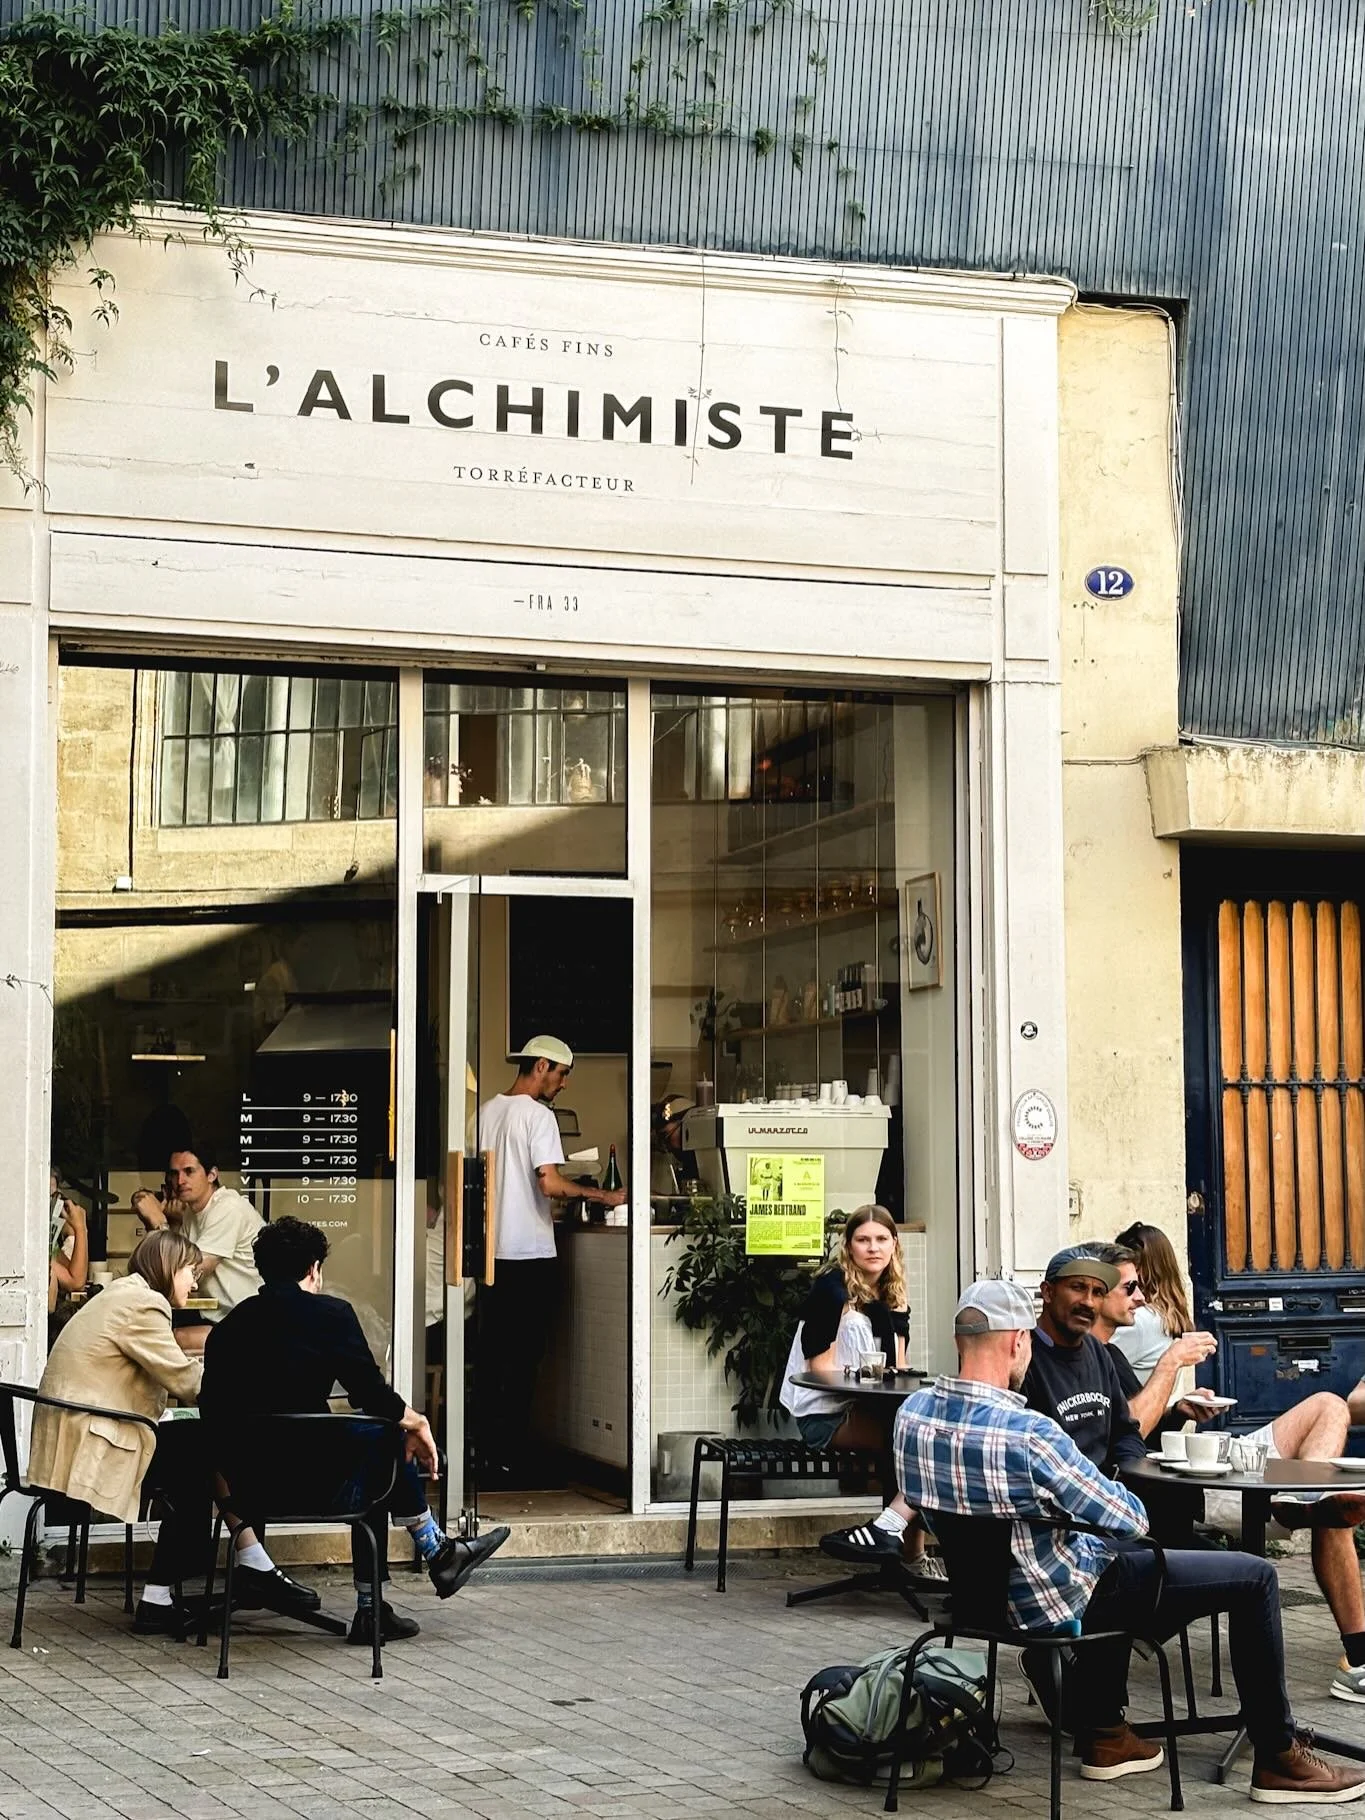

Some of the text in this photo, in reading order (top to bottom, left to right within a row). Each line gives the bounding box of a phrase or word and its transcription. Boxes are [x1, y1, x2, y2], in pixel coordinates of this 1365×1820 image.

[479, 333, 614, 358] CAFÉS FINS
[214, 360, 853, 460] L’ALCHIMISTE
[454, 466, 635, 492] TORRÉFACTEUR
[1097, 570, 1124, 595] 12
[564, 595, 578, 611] 33
[242, 1093, 252, 1102] L
[303, 1093, 311, 1102] 9
[330, 1093, 358, 1102] 1730
[240, 1114, 253, 1123] M
[303, 1114, 311, 1123] 9
[330, 1114, 358, 1123] 17.30
[240, 1136, 252, 1144] M
[302, 1135, 311, 1144] 9
[330, 1135, 358, 1144] 17.30
[241, 1157, 250, 1166] J
[302, 1155, 310, 1165] 9
[329, 1155, 357, 1165] 17.30
[240, 1176, 250, 1185] V
[302, 1176, 310, 1185] 9
[329, 1176, 357, 1185] 17.30
[297, 1195, 310, 1203] 10
[329, 1195, 357, 1203] 17.30
[749, 1203, 807, 1216] JAMES BERTRAND
[1065, 1413, 1079, 1421] NEW
